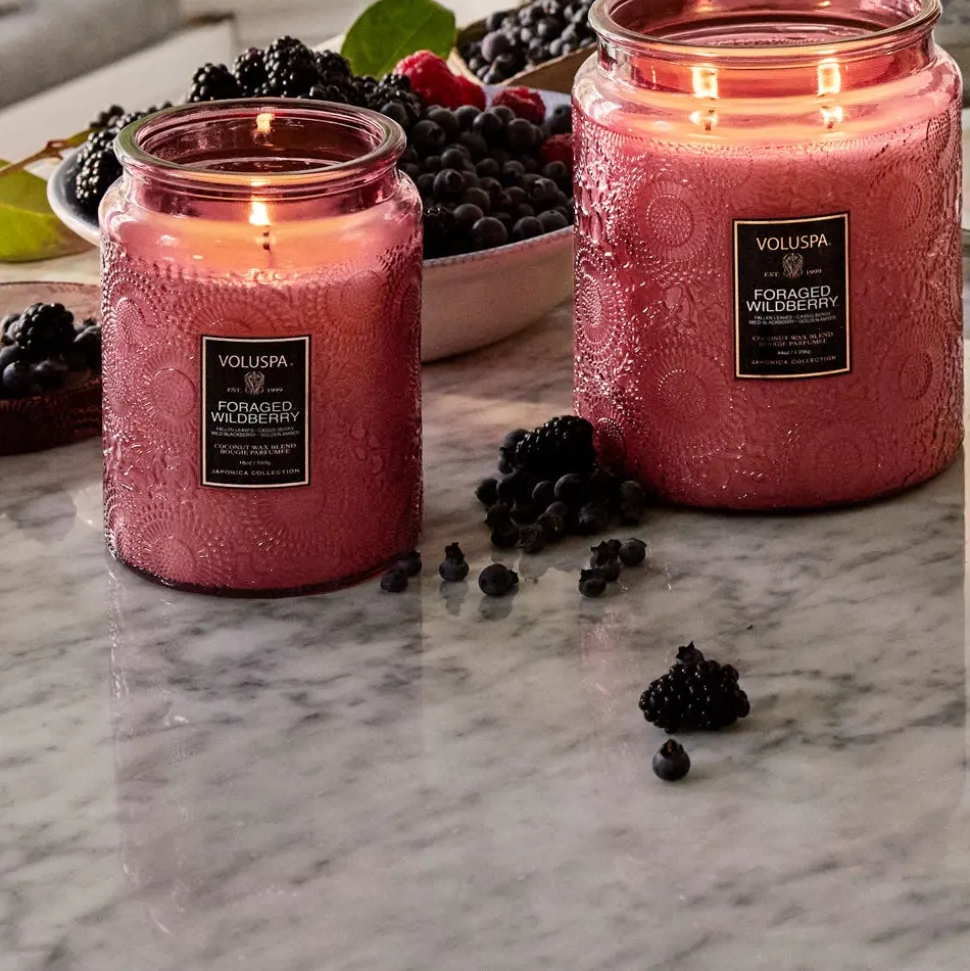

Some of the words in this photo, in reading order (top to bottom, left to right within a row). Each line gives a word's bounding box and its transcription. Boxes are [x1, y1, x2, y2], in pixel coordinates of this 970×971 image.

[756, 233, 829, 251] VOLUSPA
[754, 285, 831, 301] FORAGED
[746, 296, 839, 312] WILDBERRY
[809, 331, 834, 340] BLEND
[218, 355, 288, 368] VOLUSPA
[791, 355, 837, 365] COLLECTION
[218, 401, 292, 412] FORAGED
[211, 411, 300, 424] WILDBERRY
[251, 468, 300, 476] COLLECTION
